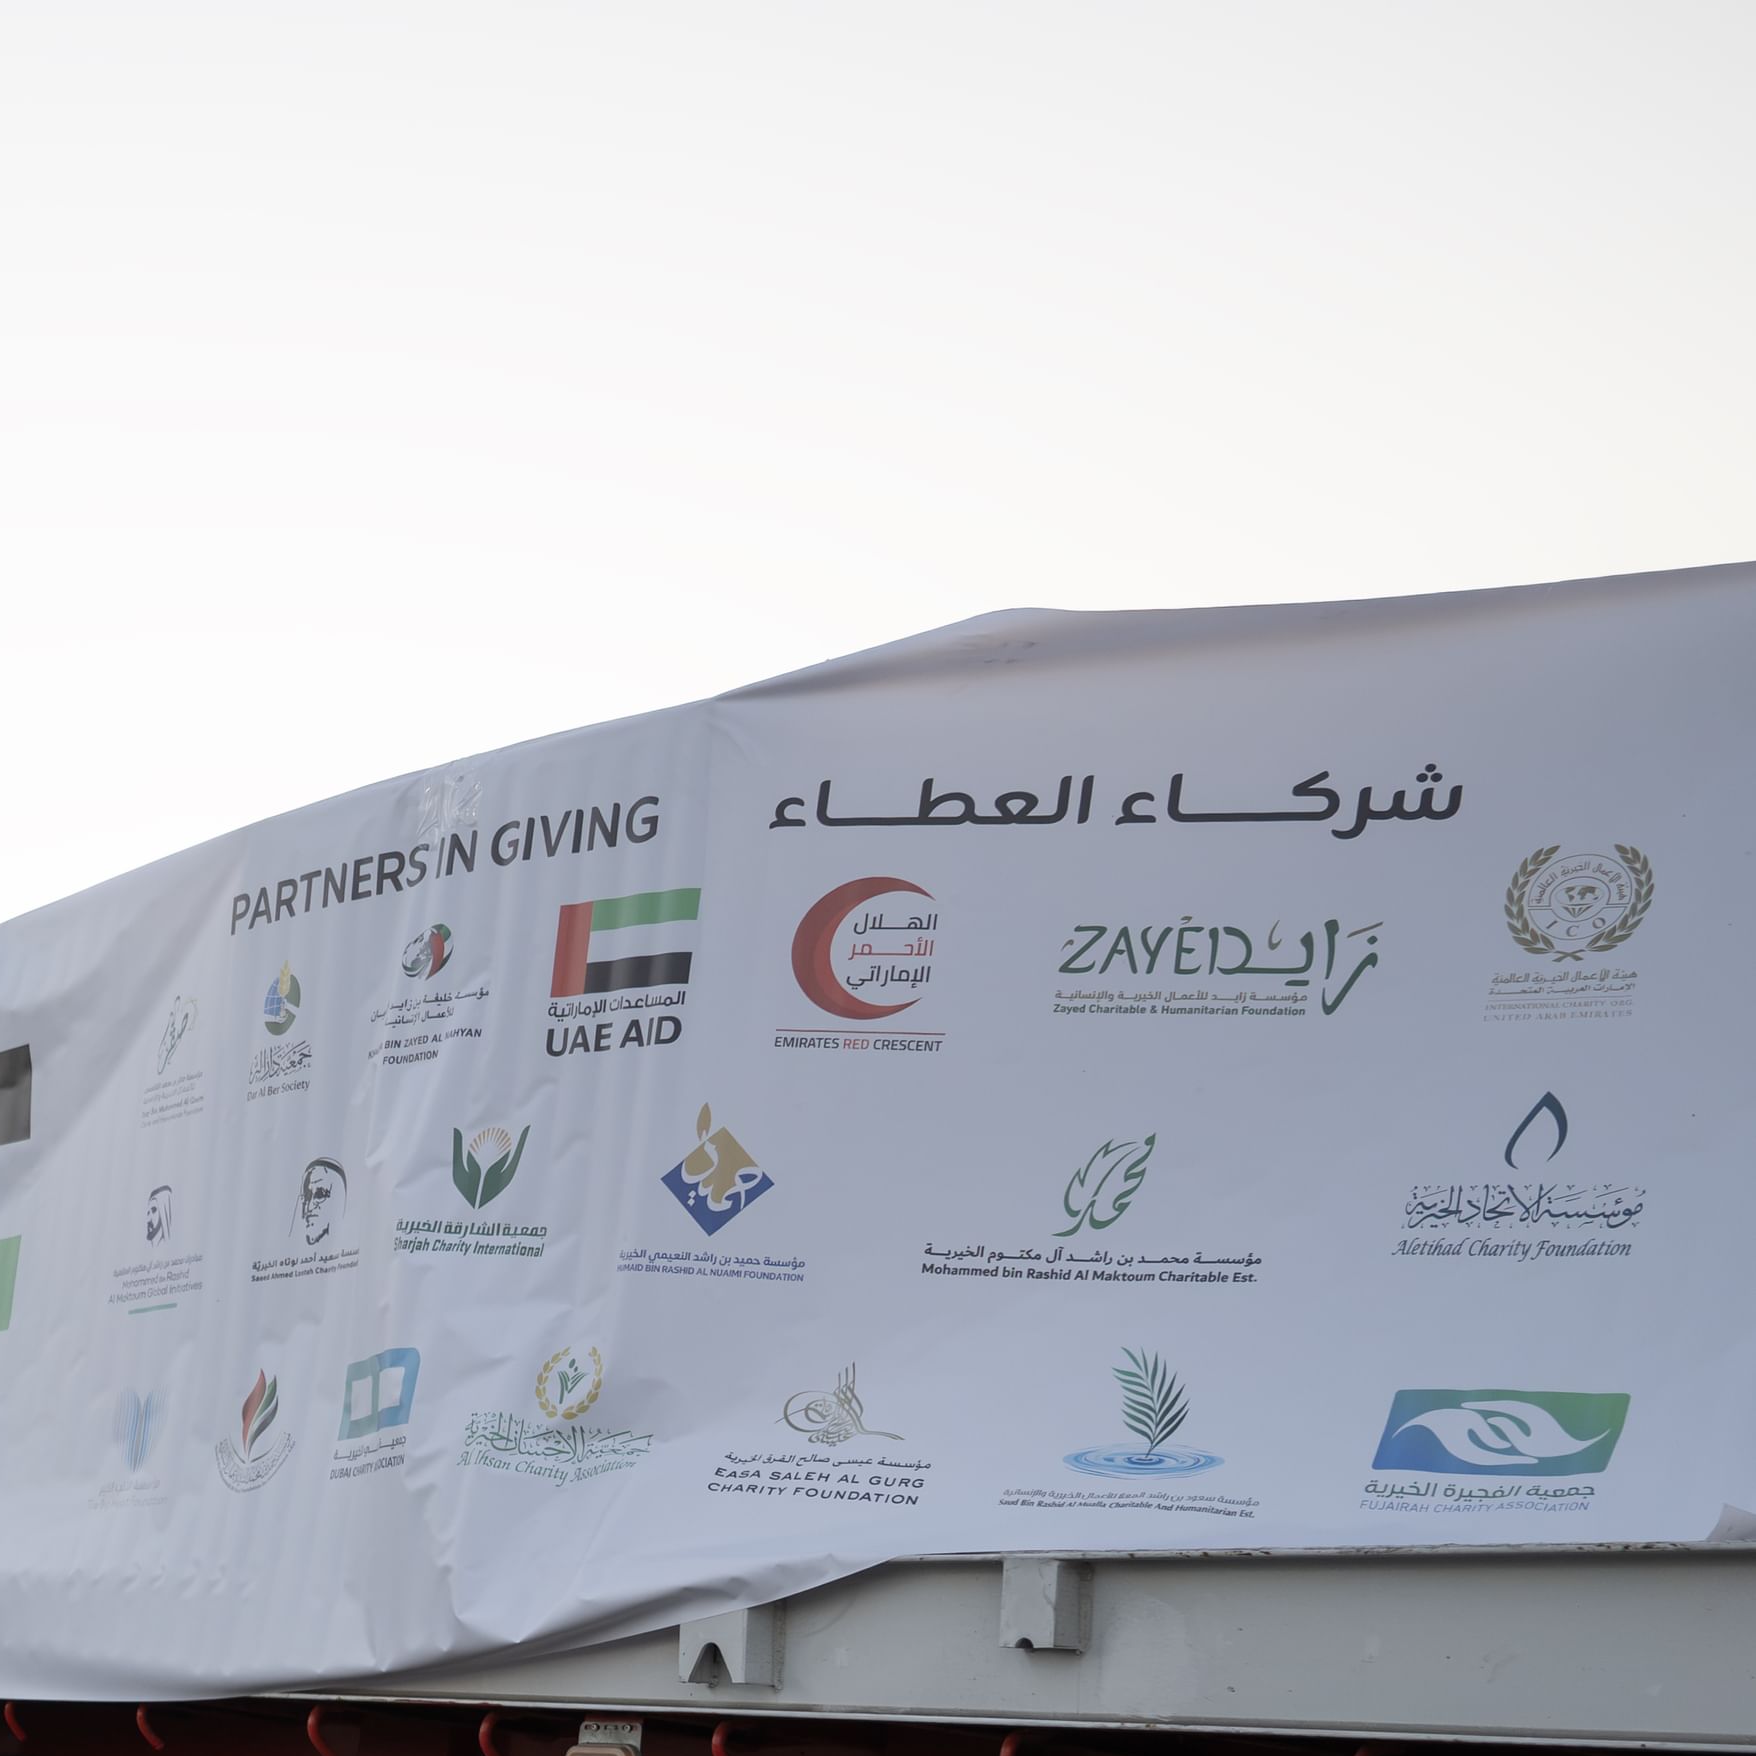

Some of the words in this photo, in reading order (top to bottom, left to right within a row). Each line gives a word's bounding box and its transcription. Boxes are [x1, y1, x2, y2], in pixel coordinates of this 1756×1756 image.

[769, 774, 1095, 829] العطاء
[1115, 762, 1464, 840] شركاء
[231, 843, 429, 935] PARTNERS
[435, 830, 477, 879] IN
[490, 795, 659, 866] GIVING
[854, 913, 937, 934] الهلال
[848, 937, 934, 960] الأحمر
[847, 966, 931, 989] الإماراتي
[610, 991, 685, 1011] المساعدات
[1118, 991, 1161, 1001] الخيرية
[1212, 991, 1248, 1003] زايد
[1249, 993, 1307, 1004] مؤسسة
[548, 1000, 606, 1022] الإماراتية
[1053, 1004, 1086, 1015] Zayed
[1089, 1004, 1146, 1015] Charitable
[1150, 1005, 1158, 1014] &
[1161, 1005, 1238, 1015] Humanitarian
[1241, 1006, 1305, 1016] Foundation
[385, 1040, 401, 1049] BIN
[404, 1035, 428, 1048] ZAYED
[432, 1034, 442, 1042] AL
[546, 1023, 613, 1056] UAE
[619, 1016, 682, 1048] AID
[774, 1037, 839, 1049] EMIRATES
[843, 1039, 869, 1049] RED
[873, 1039, 942, 1051] CRESCENT
[383, 1050, 438, 1064] FOUNDATION
[267, 1085, 280, 1096] Ber
[281, 1080, 310, 1093] Society
[396, 1218, 442, 1234] الخيرية
[444, 1221, 500, 1238] الشارقة
[502, 1223, 547, 1239] جمعية
[394, 1237, 430, 1253] Sharjah
[432, 1239, 471, 1256] Charity
[473, 1240, 544, 1257] International
[924, 1243, 984, 1259] الخيرية
[1046, 1246, 1063, 1263] آل
[1392, 1237, 1469, 1256] Aletihad
[1468, 1239, 1530, 1262] Charity
[1530, 1240, 1632, 1260] Foundation
[648, 1252, 691, 1264] النعيمي
[693, 1252, 717, 1265] راشد
[719, 1256, 732, 1266] بن
[734, 1255, 761, 1266] حميد
[763, 1257, 805, 1270] مؤسسة
[988, 1249, 1042, 1263] مكتوم
[1066, 1251, 1112, 1265] راشد
[1117, 1253, 1133, 1266] بن
[1138, 1252, 1189, 1265] محمد
[1193, 1252, 1262, 1267] مؤسسة
[645, 1265, 660, 1273] BIN
[662, 1266, 694, 1275] RASHID
[696, 1268, 707, 1276] AL
[710, 1269, 741, 1278] NUAIMI
[744, 1270, 803, 1281] FOUNDATION
[922, 1264, 998, 1278] Mohammed
[1002, 1266, 1023, 1278] bin
[1027, 1267, 1070, 1280] Rashid
[1074, 1269, 1089, 1281] Al
[1092, 1270, 1155, 1282] Maktoum
[1159, 1271, 1228, 1283] Charitable
[1232, 1272, 1258, 1283] Est.
[796, 1454, 830, 1466] صالح
[877, 1458, 931, 1471] مؤسسة
[330, 1467, 351, 1479] DUBAI
[457, 1452, 471, 1466] Al
[515, 1460, 568, 1487] Charity
[570, 1459, 637, 1482] Association
[715, 1467, 761, 1478] EASA
[769, 1470, 830, 1482] SALEH
[837, 1474, 860, 1484] AL
[869, 1475, 925, 1489] GURG
[708, 1482, 788, 1495] CHARITY
[793, 1487, 919, 1505] FOUNDATION
[1364, 1480, 1437, 1499] الخيرية
[1443, 1484, 1522, 1502] الفجيرة
[1526, 1484, 1595, 1500] جمعية
[1109, 1501, 1153, 1510] Charitable
[1155, 1502, 1173, 1511] And
[1175, 1504, 1237, 1517] Humanitarian
[1239, 1510, 1255, 1518] Est.
[1360, 1500, 1429, 1512] FUJAIRAH
[1433, 1504, 1492, 1512] CHARITY
[1496, 1501, 1590, 1511] ASSOCIATION
